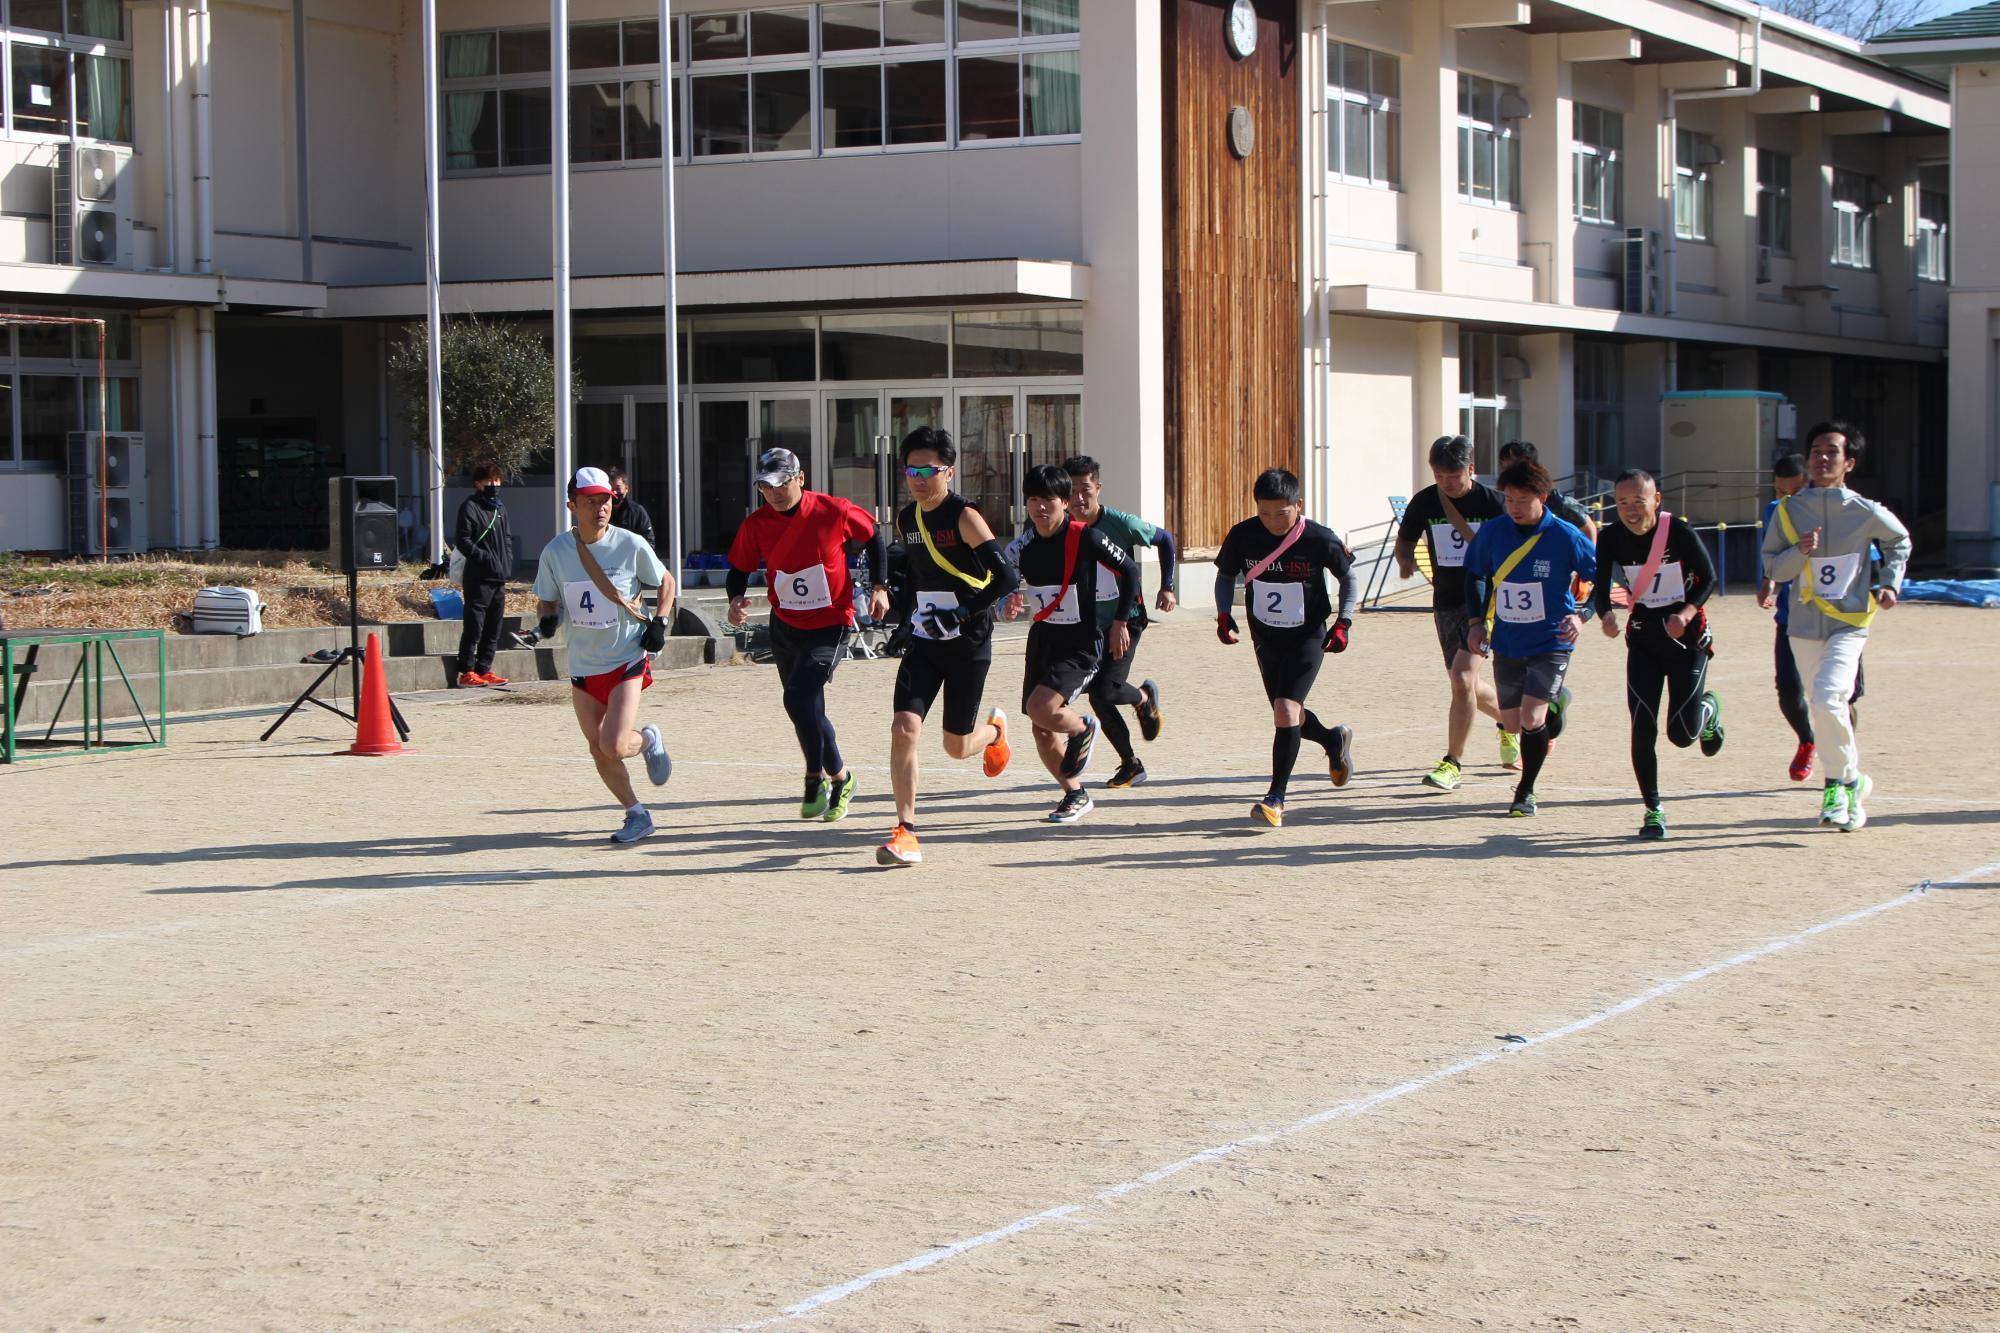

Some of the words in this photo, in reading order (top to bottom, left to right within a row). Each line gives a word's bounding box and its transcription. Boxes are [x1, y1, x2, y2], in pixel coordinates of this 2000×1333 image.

[1451, 529, 1465, 549] 9
[1820, 565, 1836, 585] 8
[793, 577, 809, 597] 6
[580, 590, 595, 613] 4
[1266, 592, 1282, 614] 2
[1503, 589, 1533, 610] 13
